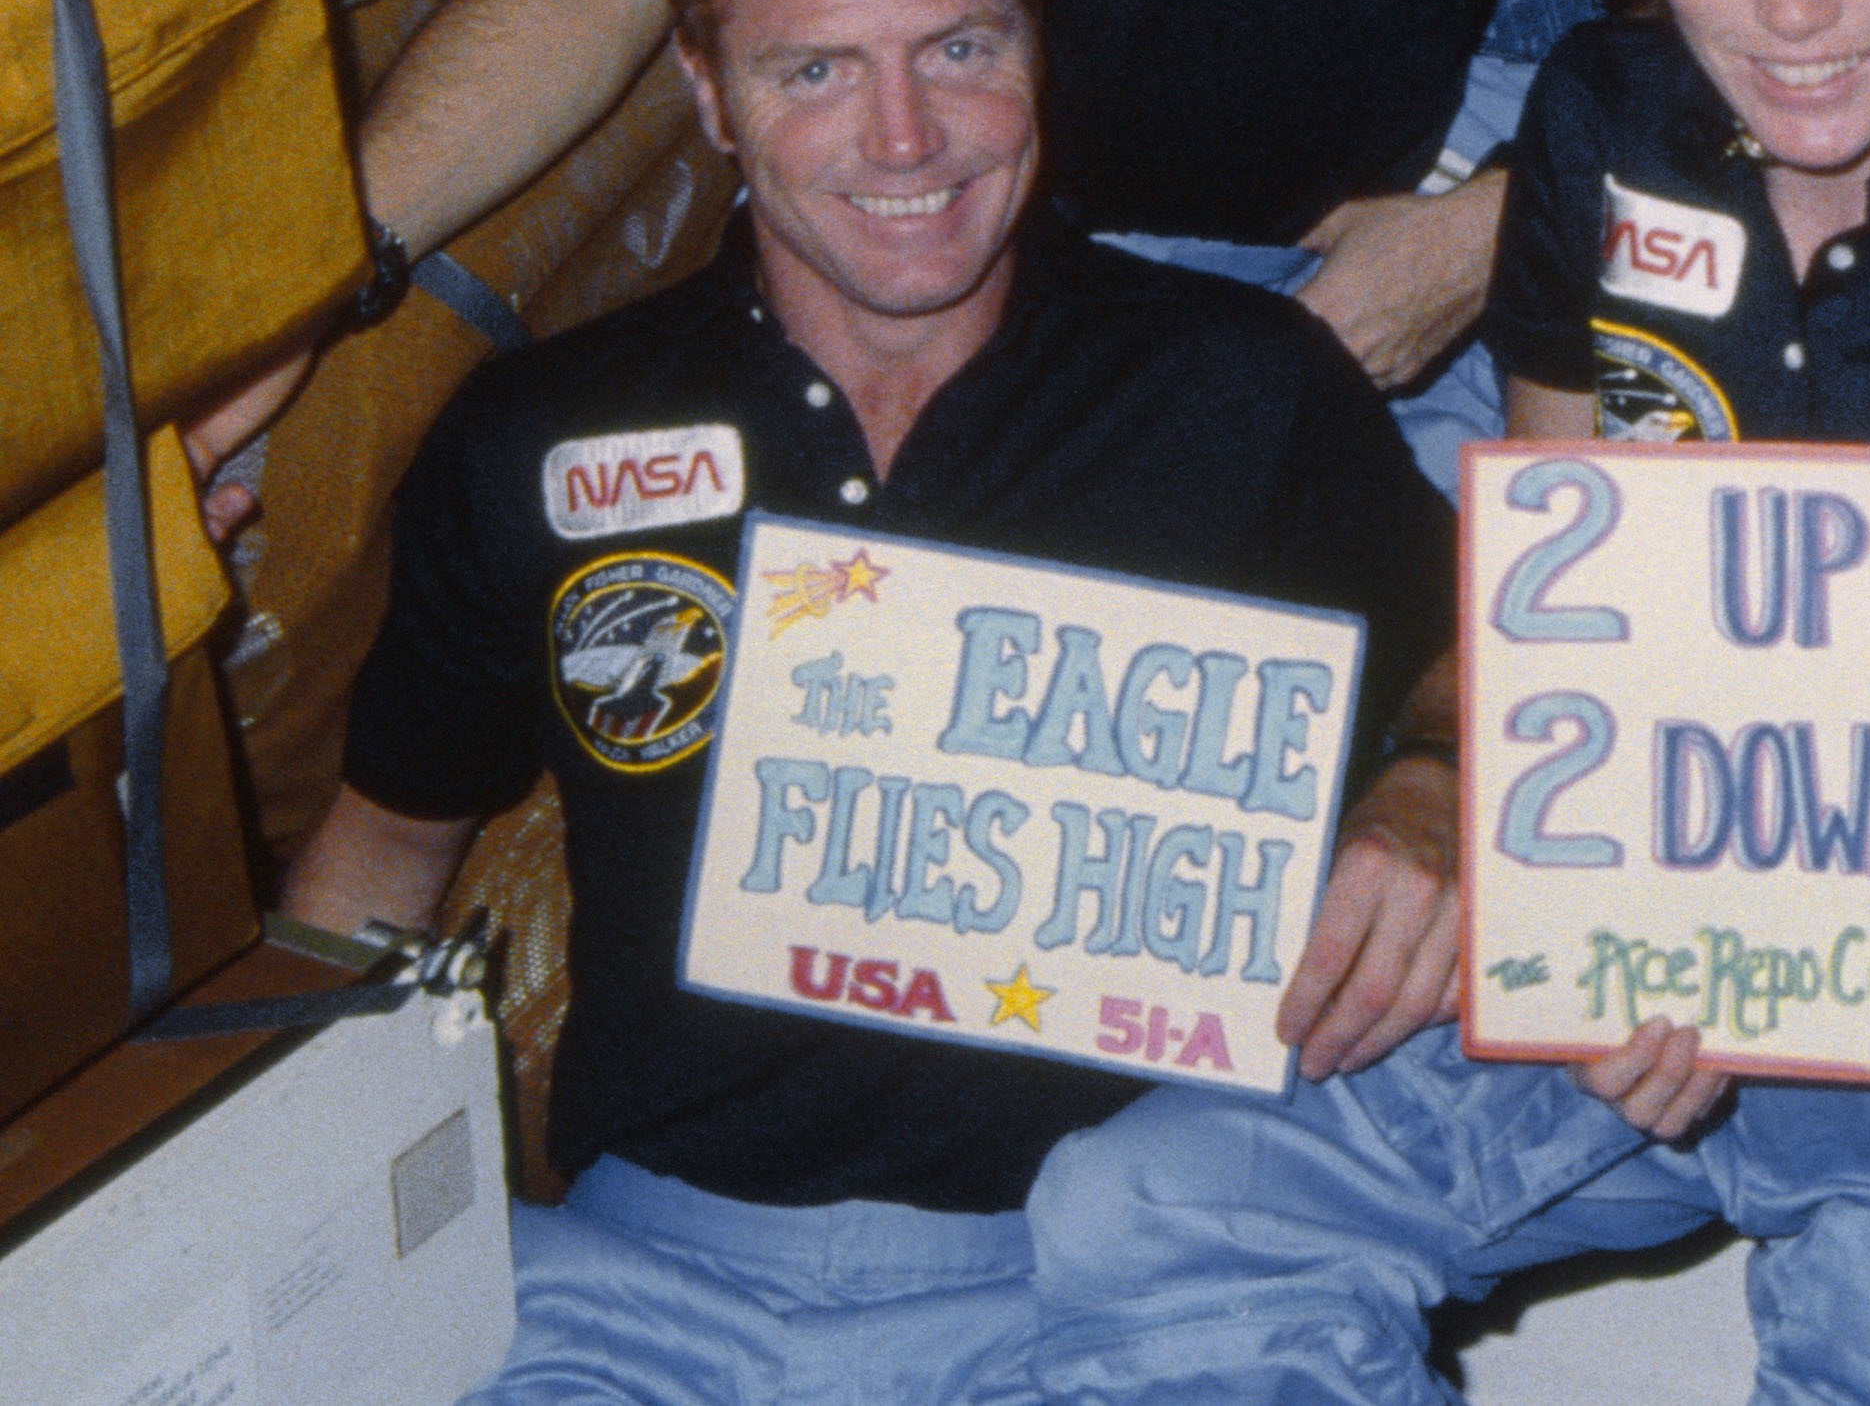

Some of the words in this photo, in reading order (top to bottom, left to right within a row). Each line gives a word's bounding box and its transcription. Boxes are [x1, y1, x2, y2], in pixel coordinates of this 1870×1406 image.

[565, 450, 725, 513] NASA
[1490, 459, 1629, 642] 2
[790, 650, 896, 738] THE
[938, 605, 1334, 821] EAGLE
[1494, 691, 1624, 868] 2
[740, 757, 1030, 936] FLIES
[1034, 801, 1295, 984] HIGH
[786, 945, 956, 1023] USA
[1094, 996, 1234, 1072] 51-A
[1576, 926, 1699, 1026] Ace
[1697, 926, 1824, 1038] Repo
